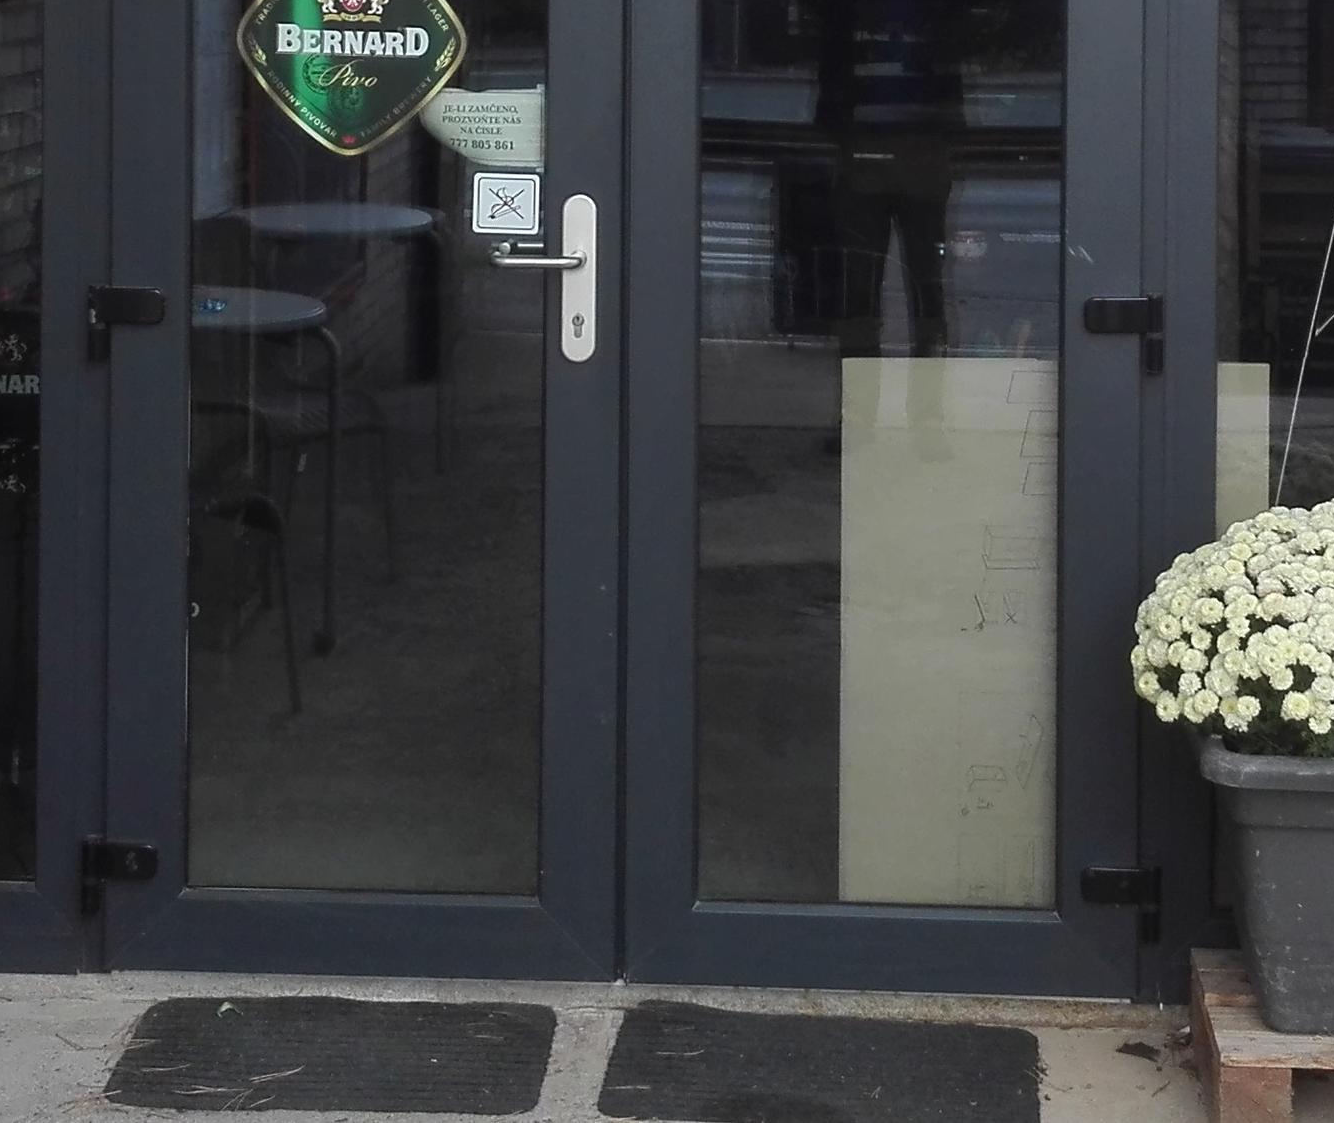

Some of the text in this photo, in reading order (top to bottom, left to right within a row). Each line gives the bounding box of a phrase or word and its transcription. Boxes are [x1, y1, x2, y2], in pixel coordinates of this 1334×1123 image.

[426, 2, 450, 32] LAGER
[275, 22, 430, 58] BERNARD
[319, 59, 379, 91] Pivo
[300, 107, 338, 138] PIVOVAR
[442, 103, 519, 115] JE-LI ZAMČENO,
[460, 126, 474, 135] NA
[471, 138, 492, 150] 805
[494, 138, 515, 150] 861
